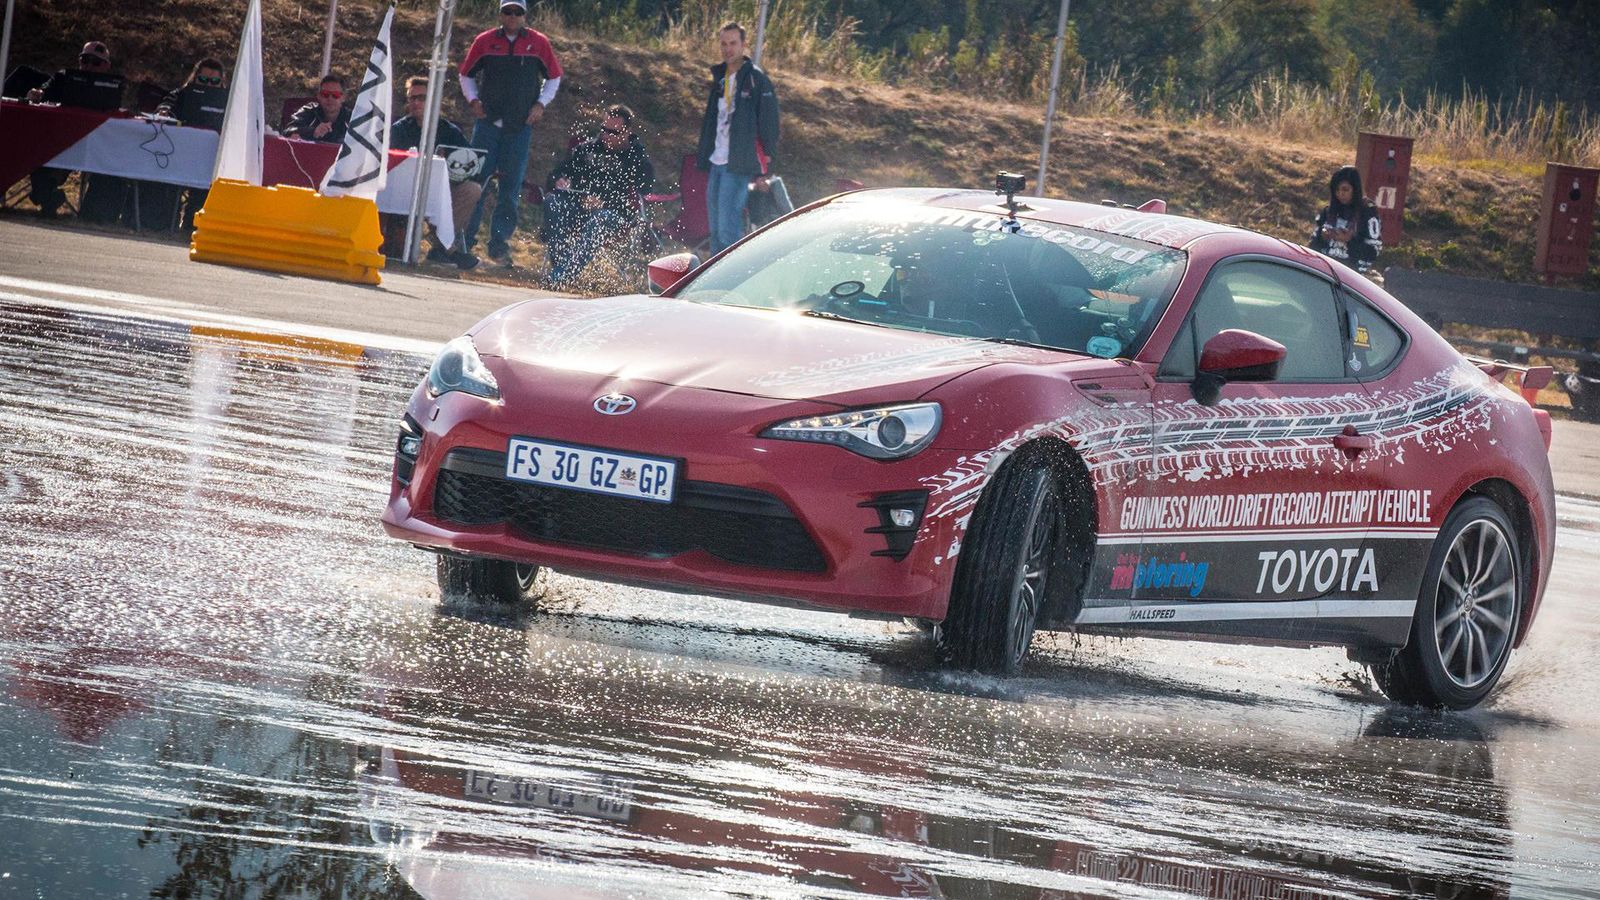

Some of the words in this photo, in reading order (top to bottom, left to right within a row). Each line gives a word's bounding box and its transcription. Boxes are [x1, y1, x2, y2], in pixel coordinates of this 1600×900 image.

[513, 444, 541, 477] FS
[552, 449, 580, 483] 30
[590, 456, 620, 489] GZ
[639, 463, 668, 495] GP
[1120, 496, 1186, 529] GUINNESS
[1187, 494, 1236, 529] WORLD
[1235, 493, 1271, 526] DRIFT
[1271, 492, 1321, 525] RECORD
[1319, 491, 1377, 524] ATTEMPT
[1377, 489, 1432, 523] VEHICLE
[1255, 547, 1379, 594] TOYOTA
[1129, 608, 1176, 620] HALLSPEED
